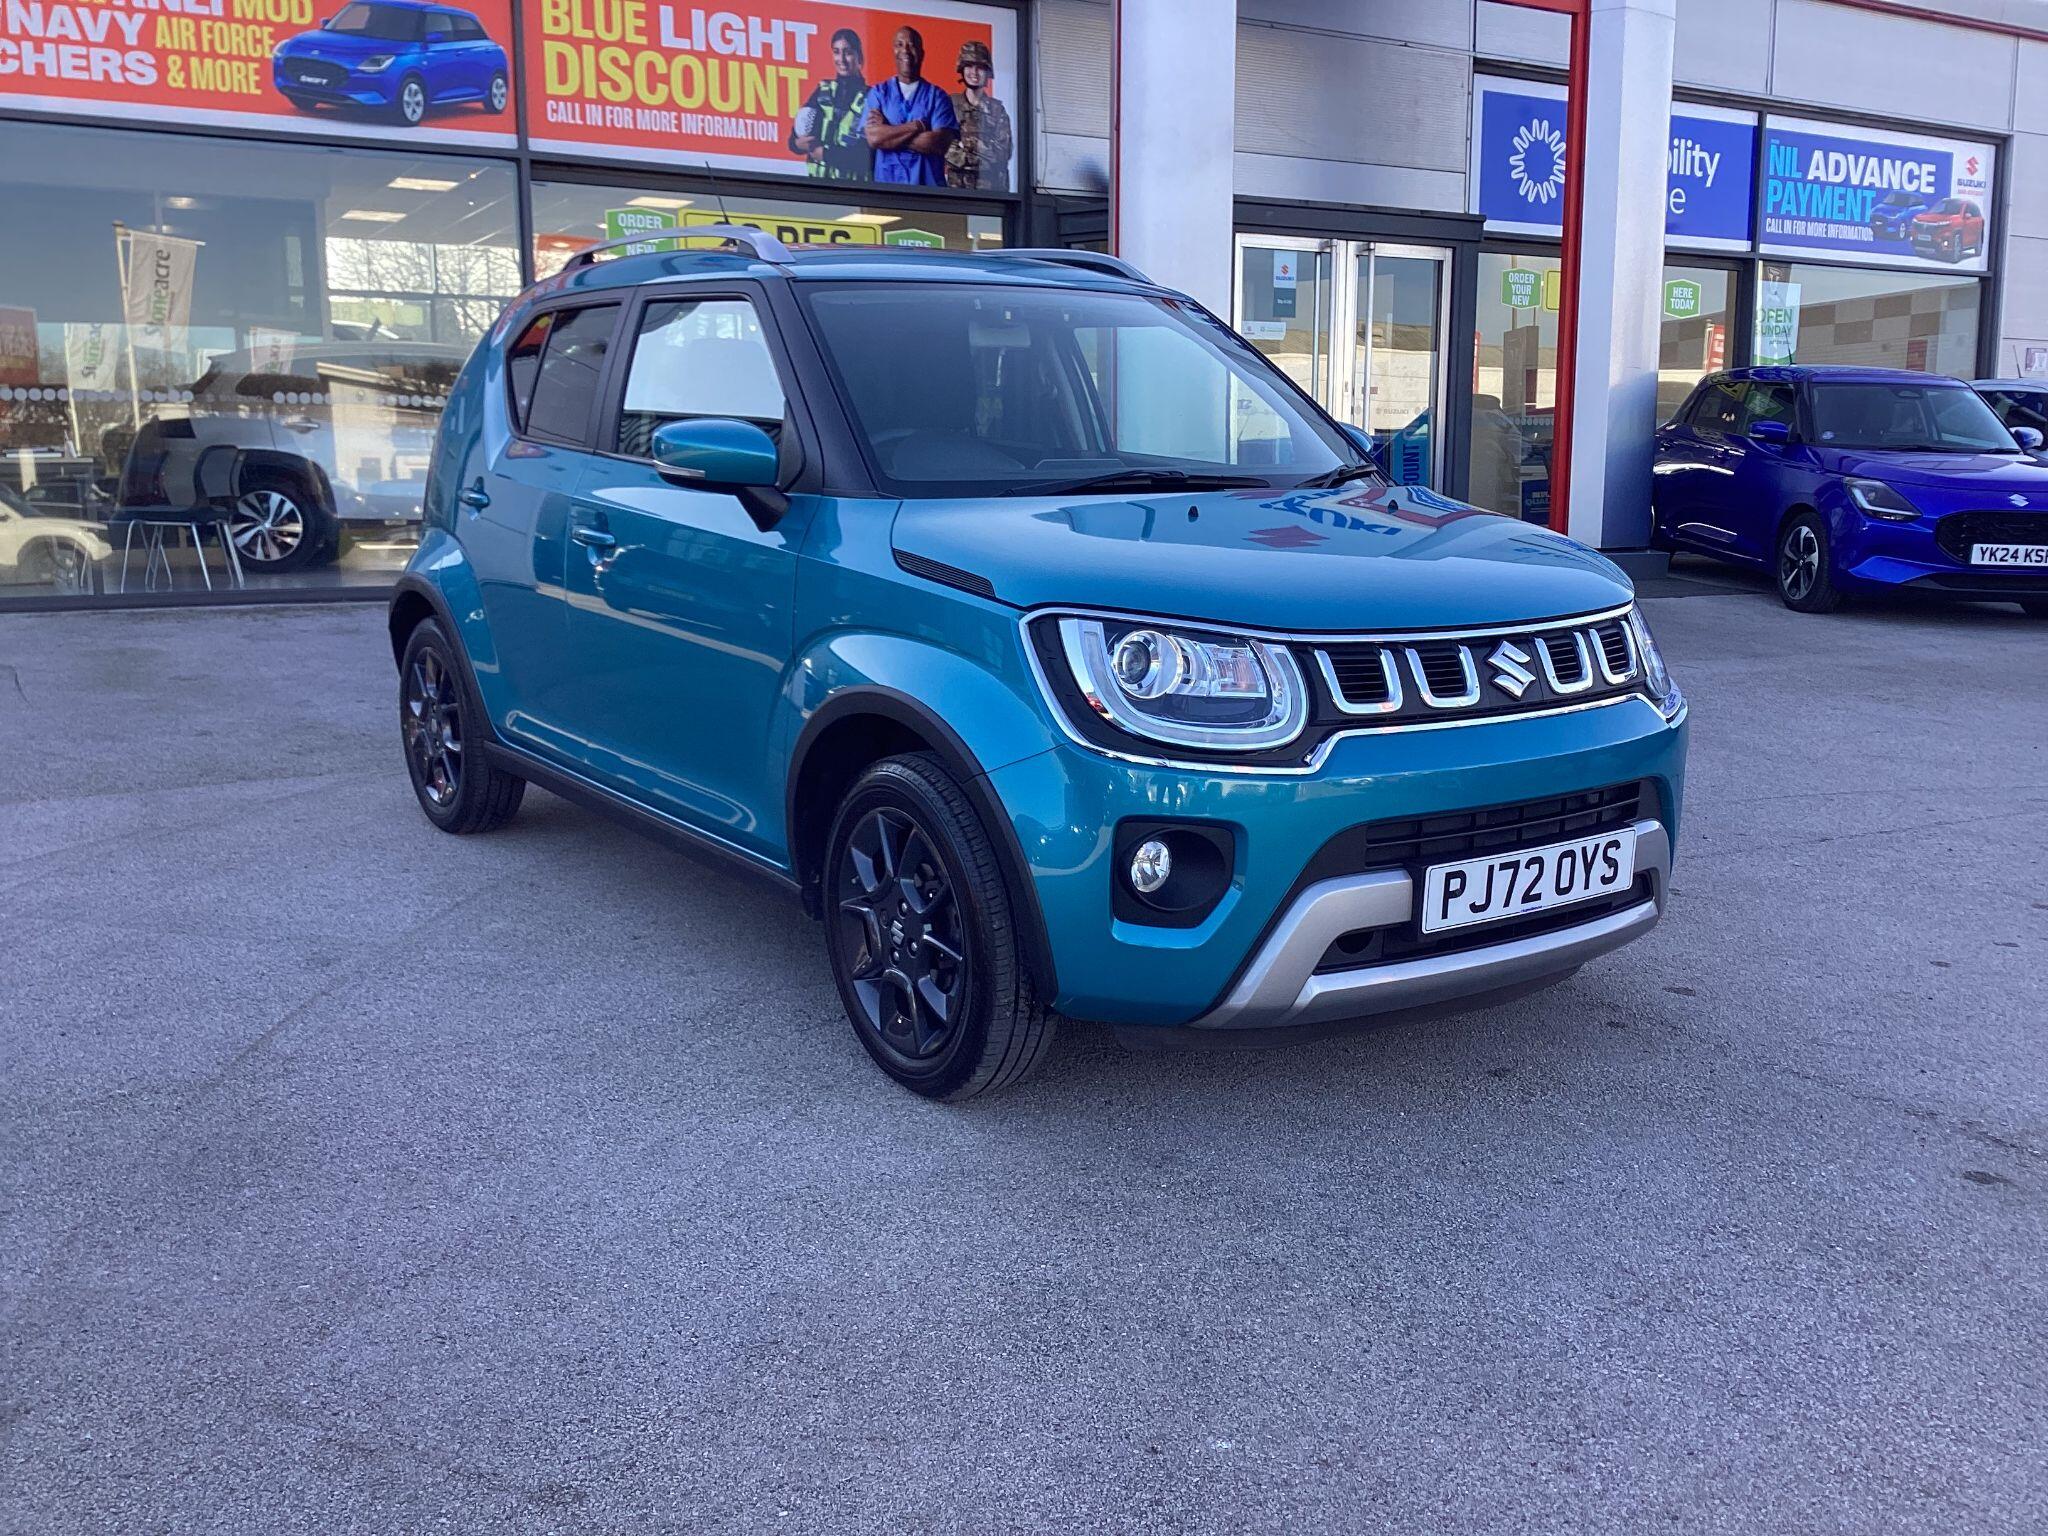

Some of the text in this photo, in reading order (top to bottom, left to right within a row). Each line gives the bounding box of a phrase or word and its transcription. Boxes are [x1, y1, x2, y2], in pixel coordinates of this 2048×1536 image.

[6, 0, 147, 46] NAVY
[155, 15, 276, 59] AIR FORCE
[541, 0, 818, 64] BLUE LIGHT
[167, 54, 262, 95] & MORE
[543, 40, 809, 119] DISCOUNT
[546, 100, 779, 143] CALL IN FOR MORE INFORMATION
[1807, 150, 1936, 194] ADVANCE
[1766, 179, 1877, 223] PAYMENT
[617, 213, 663, 230] ORDER
[1765, 218, 1783, 234] CALL
[1793, 220, 1806, 235] FOR
[1807, 221, 1827, 237] MORE
[1827, 223, 1874, 241] INFORMATION
[1508, 272, 1535, 284] ORDER
[1511, 283, 1532, 295] YOUR
[1672, 286, 1693, 298] HERE
[1511, 294, 1530, 306] NEW
[1671, 298, 1695, 310] TODAY
[1757, 308, 1793, 323] OPEN
[1980, 546, 2020, 563] YK24
[1441, 839, 1622, 920] PJ72 OYS
